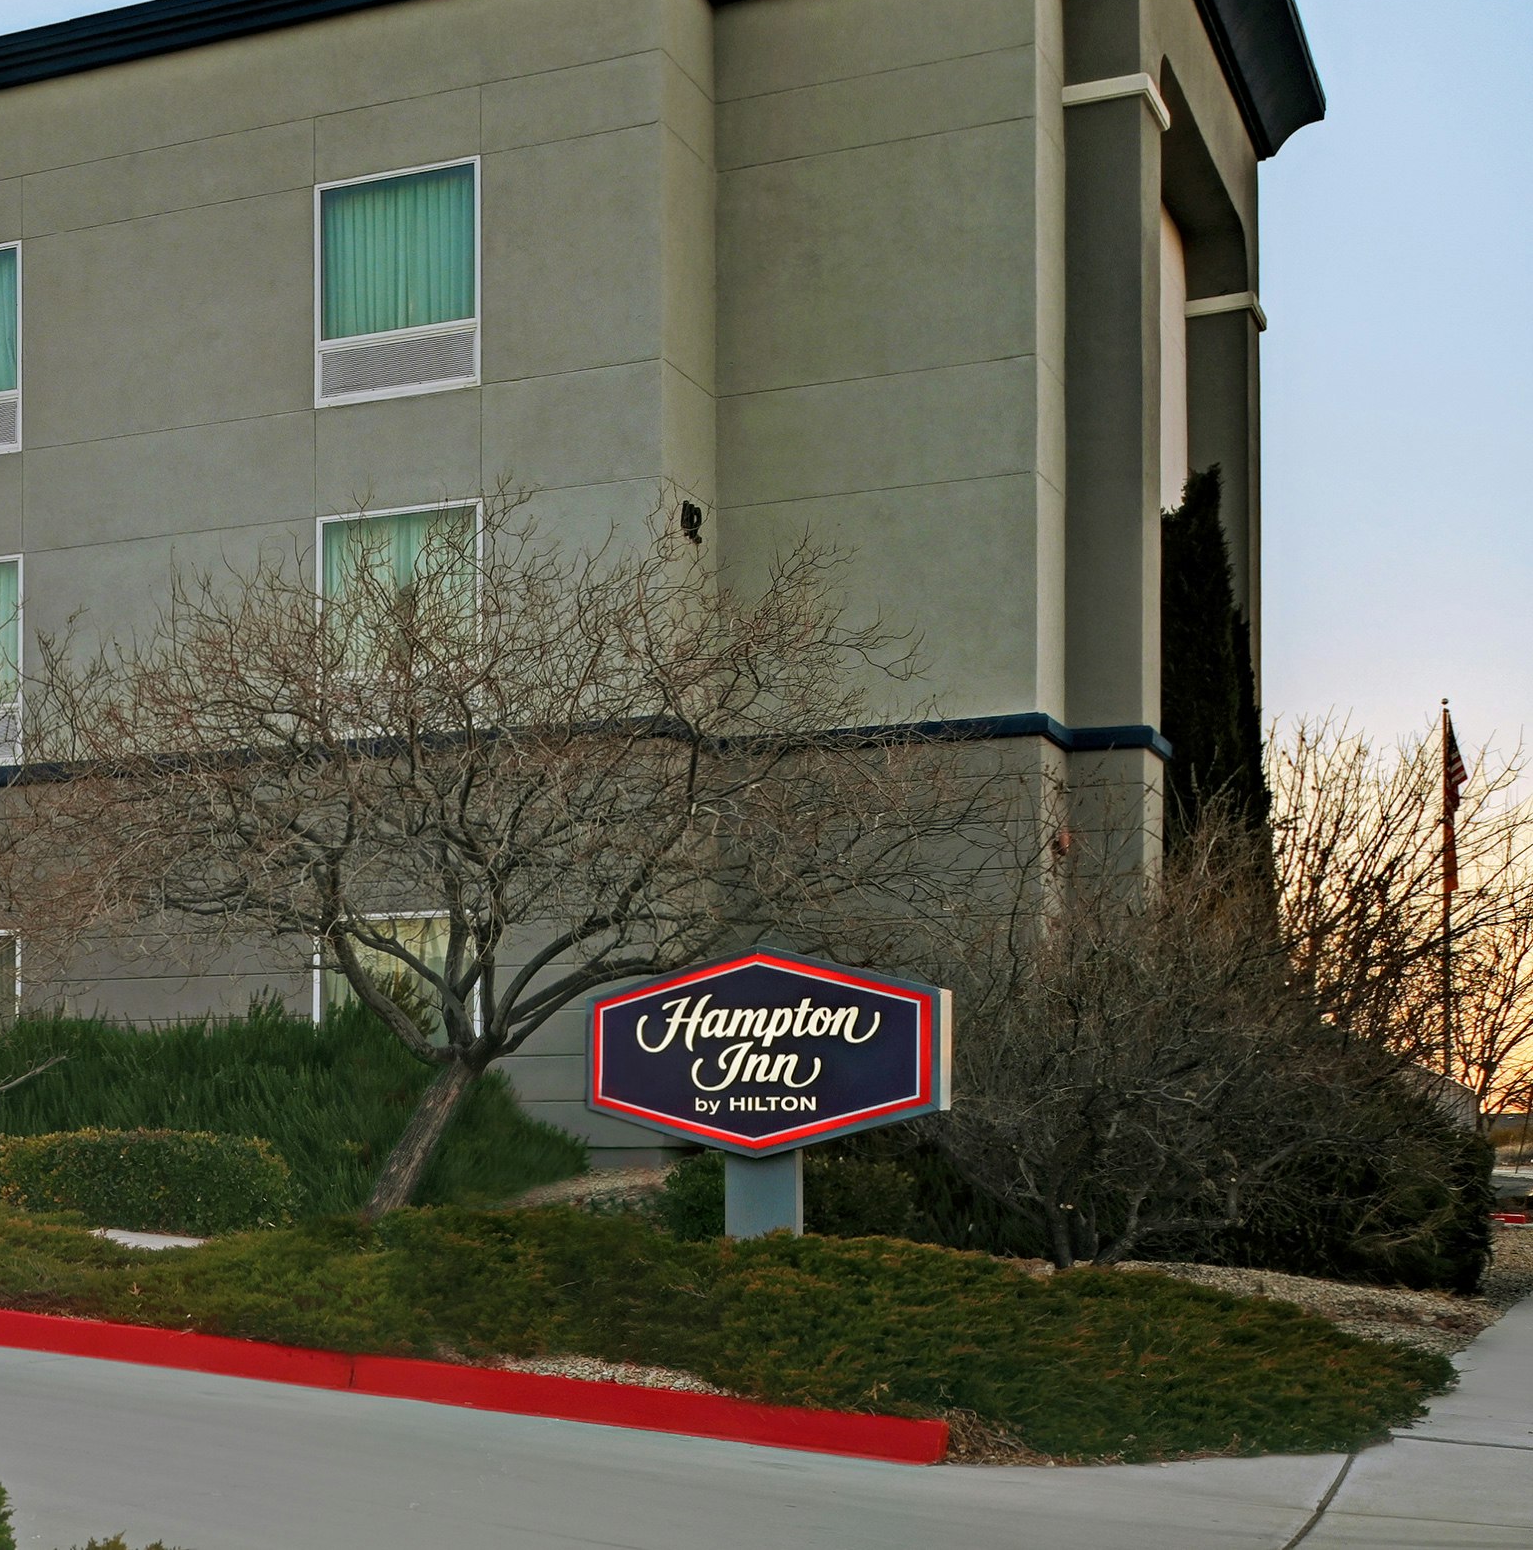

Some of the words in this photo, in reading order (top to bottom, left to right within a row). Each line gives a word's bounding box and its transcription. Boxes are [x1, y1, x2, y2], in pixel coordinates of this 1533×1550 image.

[636, 993, 881, 1053] Hampton
[690, 1041, 822, 1092] Inn
[694, 1097, 721, 1115] by
[729, 1096, 817, 1112] HILTON
